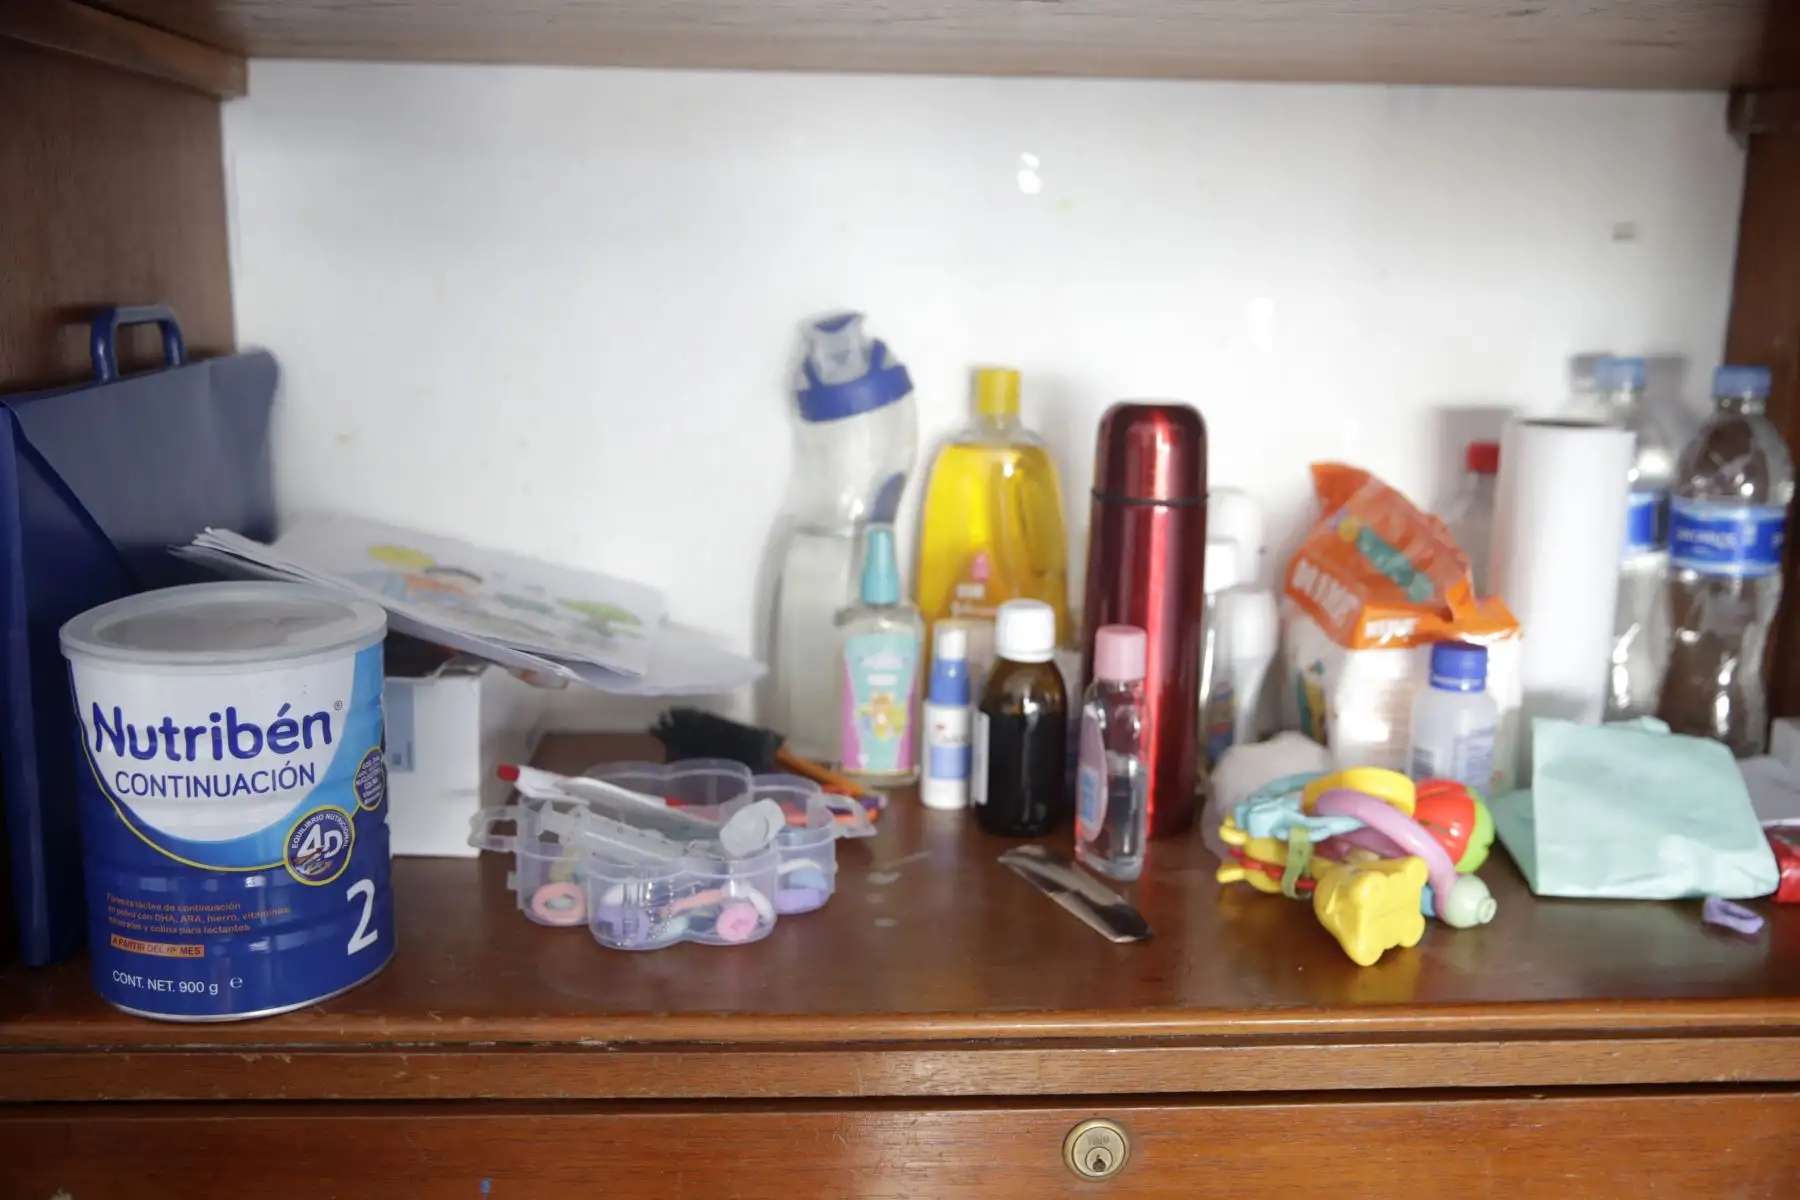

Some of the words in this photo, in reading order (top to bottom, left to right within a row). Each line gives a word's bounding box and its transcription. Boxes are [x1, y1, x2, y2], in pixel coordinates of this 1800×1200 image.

[93, 701, 332, 761] Nutribén
[115, 761, 315, 797] CONTINUACIÓN
[291, 814, 324, 849] EQUILIBRIO
[297, 823, 343, 858] 4D
[137, 912, 153, 920] con
[177, 901, 241, 912] continuación
[346, 878, 379, 956] 2
[112, 936, 119, 945] A
[119, 939, 145, 952] PARTIR
[147, 944, 165, 954] DEL
[179, 946, 201, 955] MES
[150, 924, 177, 933] colina
[179, 927, 202, 936] para
[112, 969, 144, 989] CONT.
[147, 979, 175, 992] NET.
[179, 981, 205, 993] 900
[209, 983, 219, 996] g
